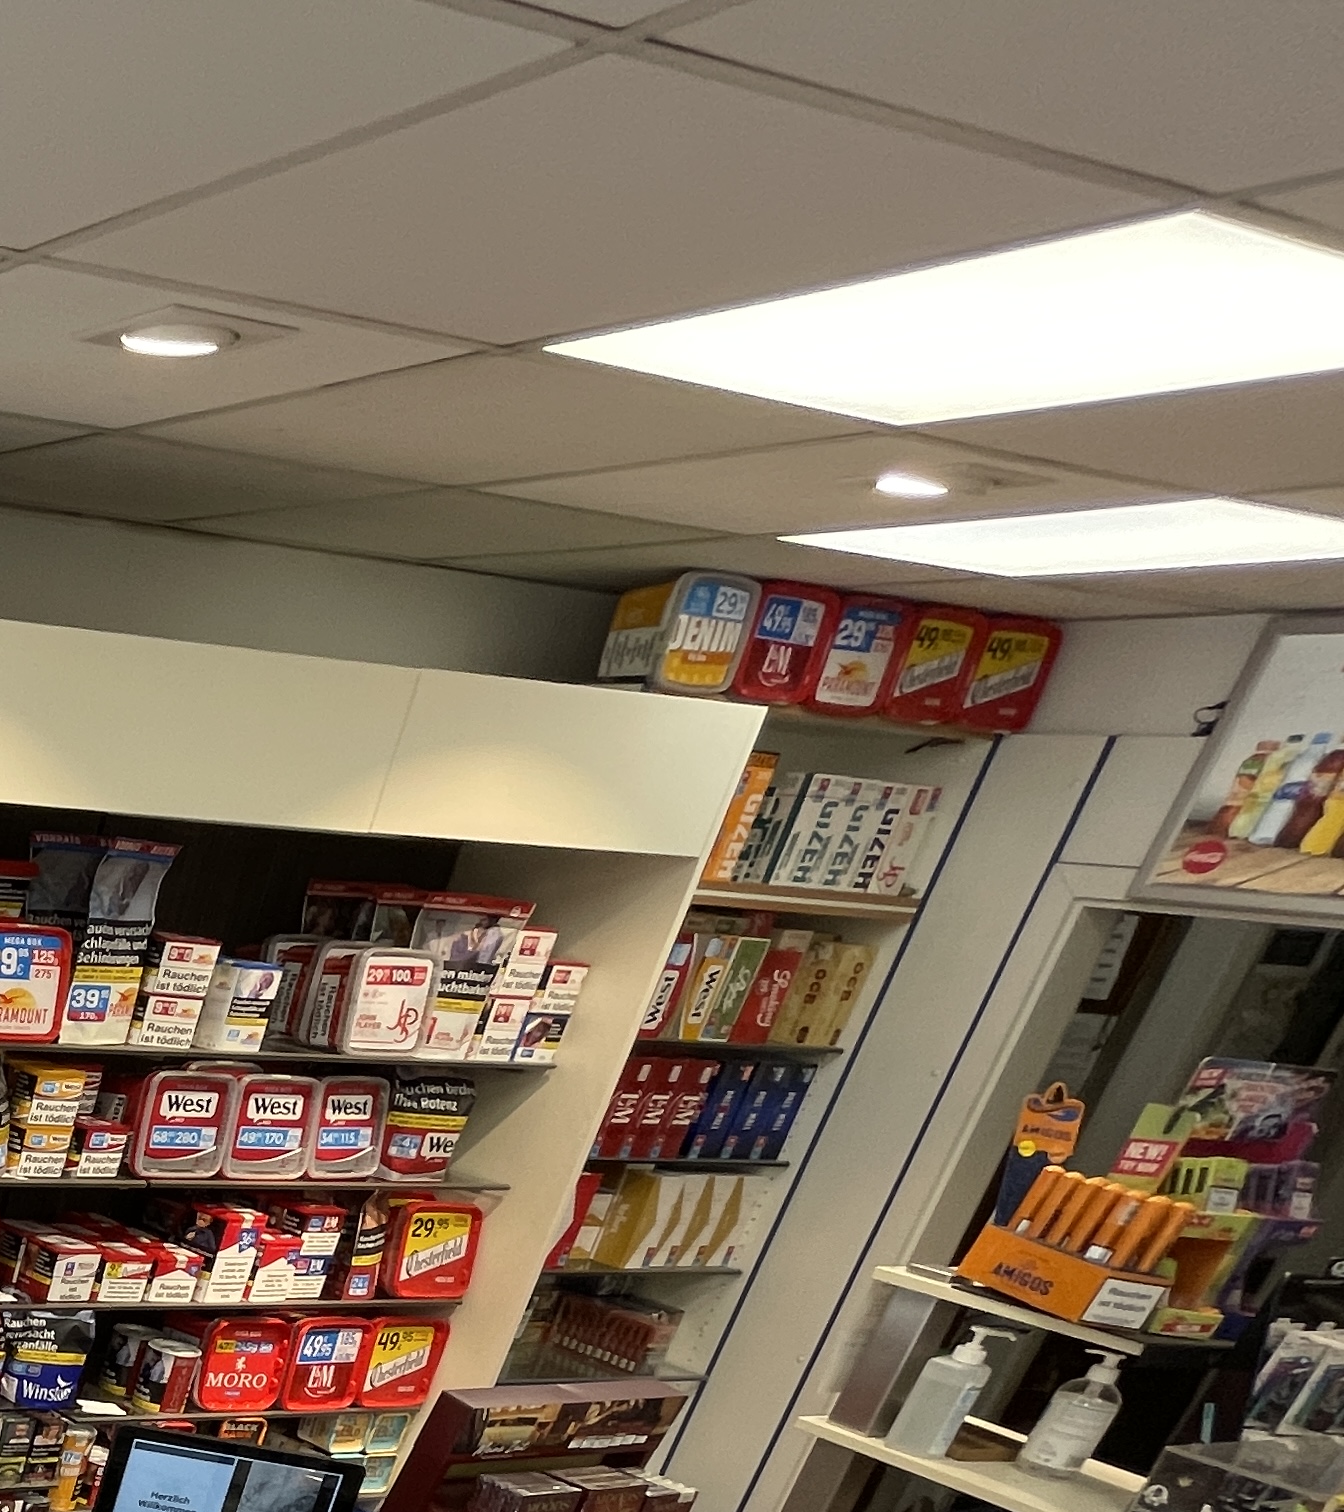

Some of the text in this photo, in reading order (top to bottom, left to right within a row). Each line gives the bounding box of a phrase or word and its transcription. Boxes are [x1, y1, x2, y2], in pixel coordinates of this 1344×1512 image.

[668, 615, 743, 653] DENIM
[162, 968, 210, 983] Rauchen
[644, 971, 676, 1025] West
[690, 968, 723, 1018] West
[35, 1101, 79, 1116] Rauchen
[166, 1094, 213, 1115] West
[252, 1096, 299, 1117] West
[1021, 1123, 1073, 1143] AMIGOS
[1123, 1140, 1175, 1162] NEW!
[406, 1233, 467, 1276] Chesterfield
[992, 1260, 1055, 1297] AMIGOS
[369, 1347, 430, 1388] Chesterfield
[205, 1371, 268, 1389] MORO
[150, 1490, 191, 1507] Herzlich
